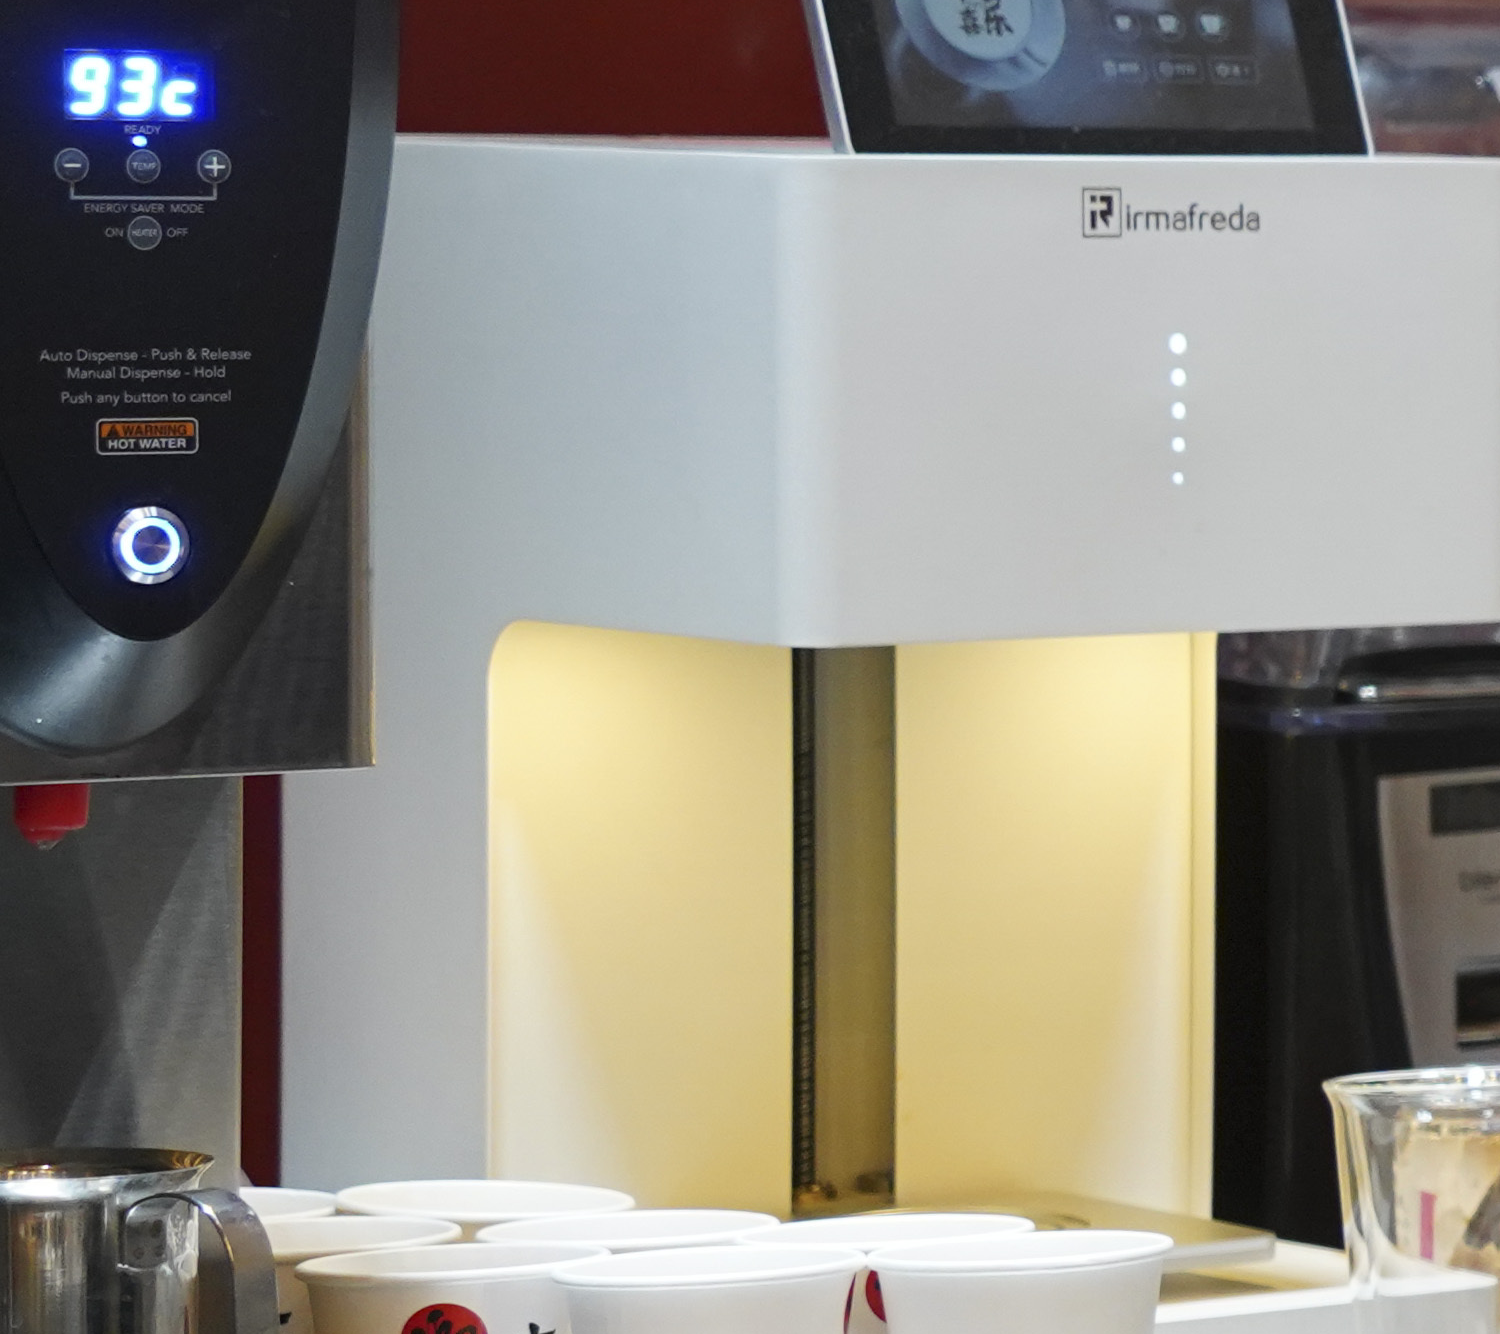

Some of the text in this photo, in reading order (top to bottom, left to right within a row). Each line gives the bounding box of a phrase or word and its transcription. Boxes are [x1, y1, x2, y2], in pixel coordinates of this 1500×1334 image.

[124, 125, 162, 135] READY
[84, 203, 205, 214] ENERGY SAVER MODE
[105, 227, 124, 238] ON
[166, 227, 189, 238] OFF
[39, 349, 73, 362] Auto
[76, 349, 138, 364] Dispense
[151, 348, 183, 361] Push
[187, 348, 198, 361] &
[201, 347, 252, 360] Release
[66, 367, 116, 380] Manual
[120, 367, 181, 382] Dispense
[194, 366, 226, 378] Hold
[61, 390, 232, 407] Push any button to cancel
[122, 424, 187, 437] WARNING
[108, 438, 187, 450] HOT WATER
